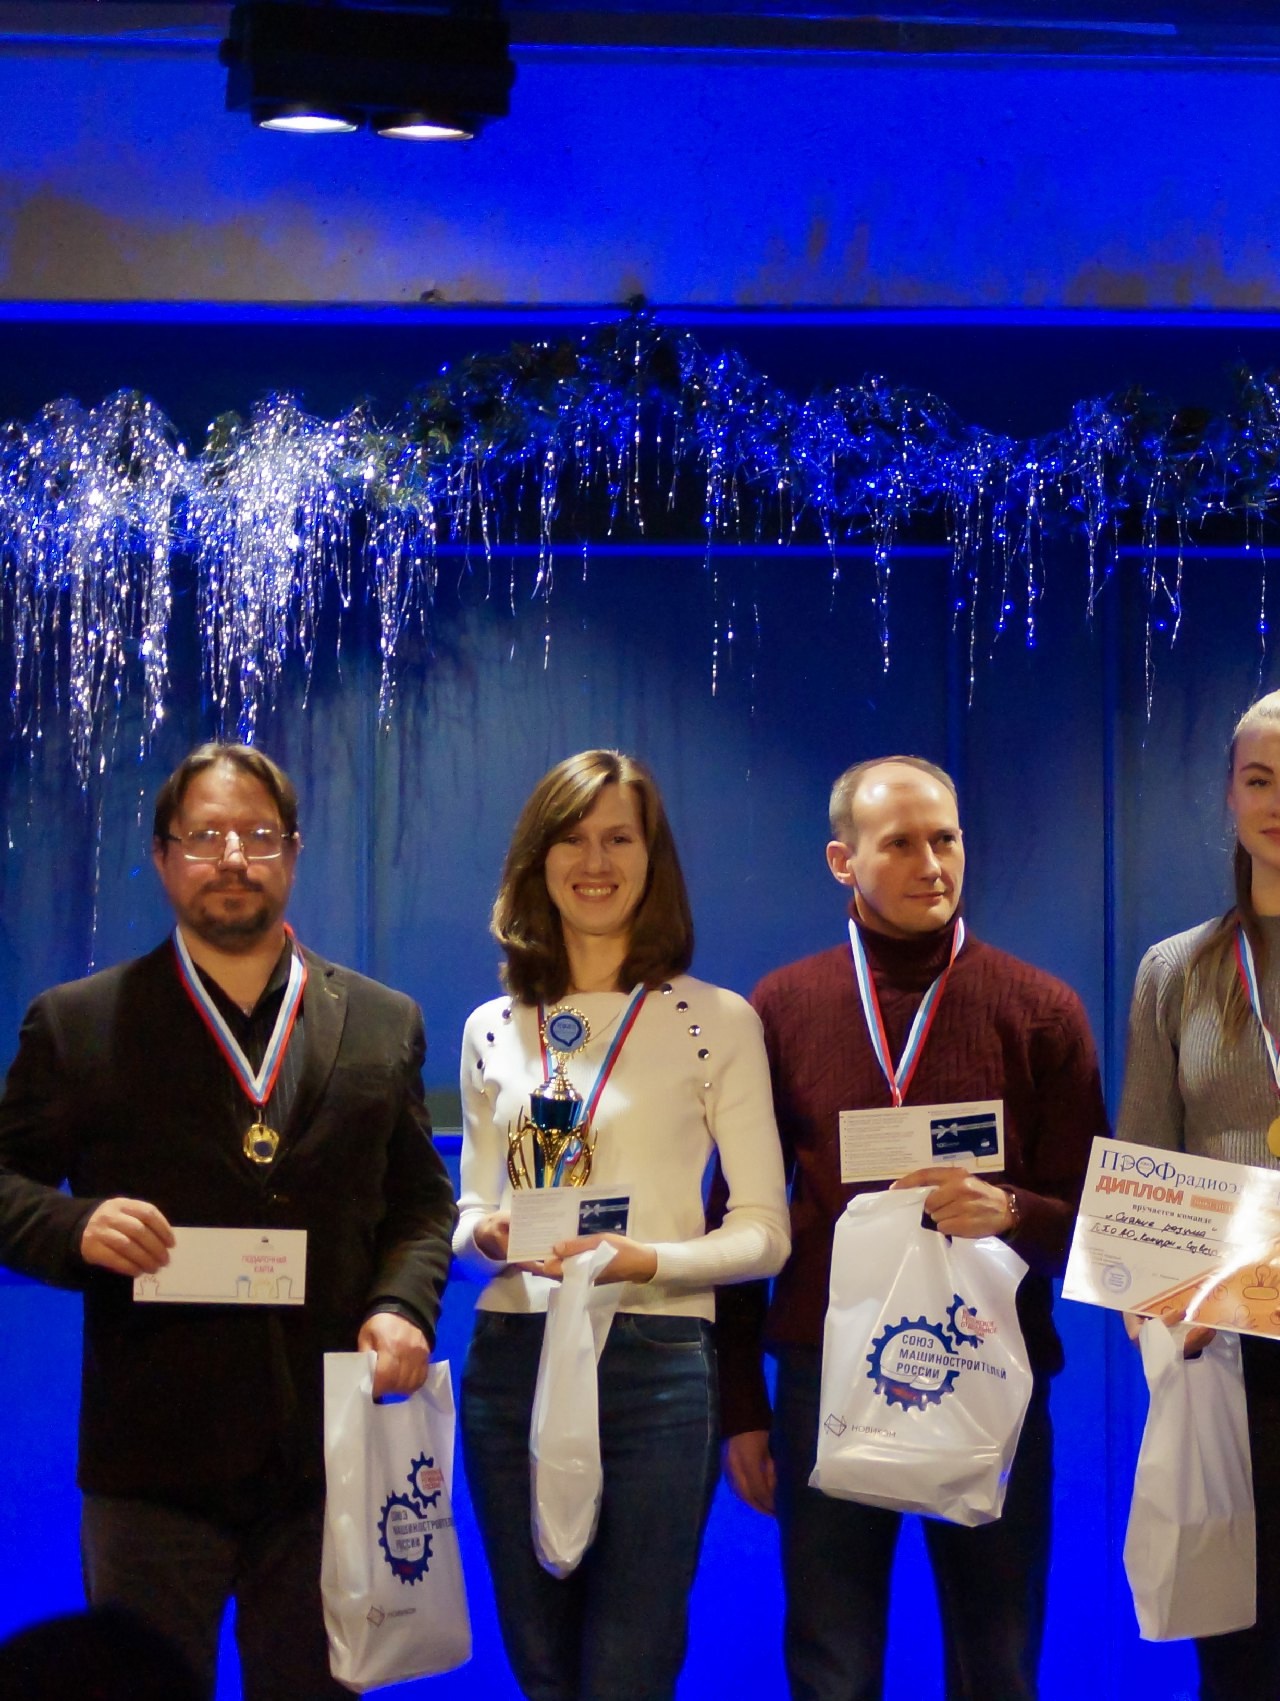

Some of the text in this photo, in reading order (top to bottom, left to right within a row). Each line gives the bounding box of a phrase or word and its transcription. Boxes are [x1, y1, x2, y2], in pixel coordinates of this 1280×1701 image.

[1096, 1175, 1185, 1205] ДИПЛОМ
[1132, 1203, 1212, 1224] вручается команде
[902, 1333, 934, 1349] СОЮЗ
[896, 1362, 940, 1380] РОССИИ
